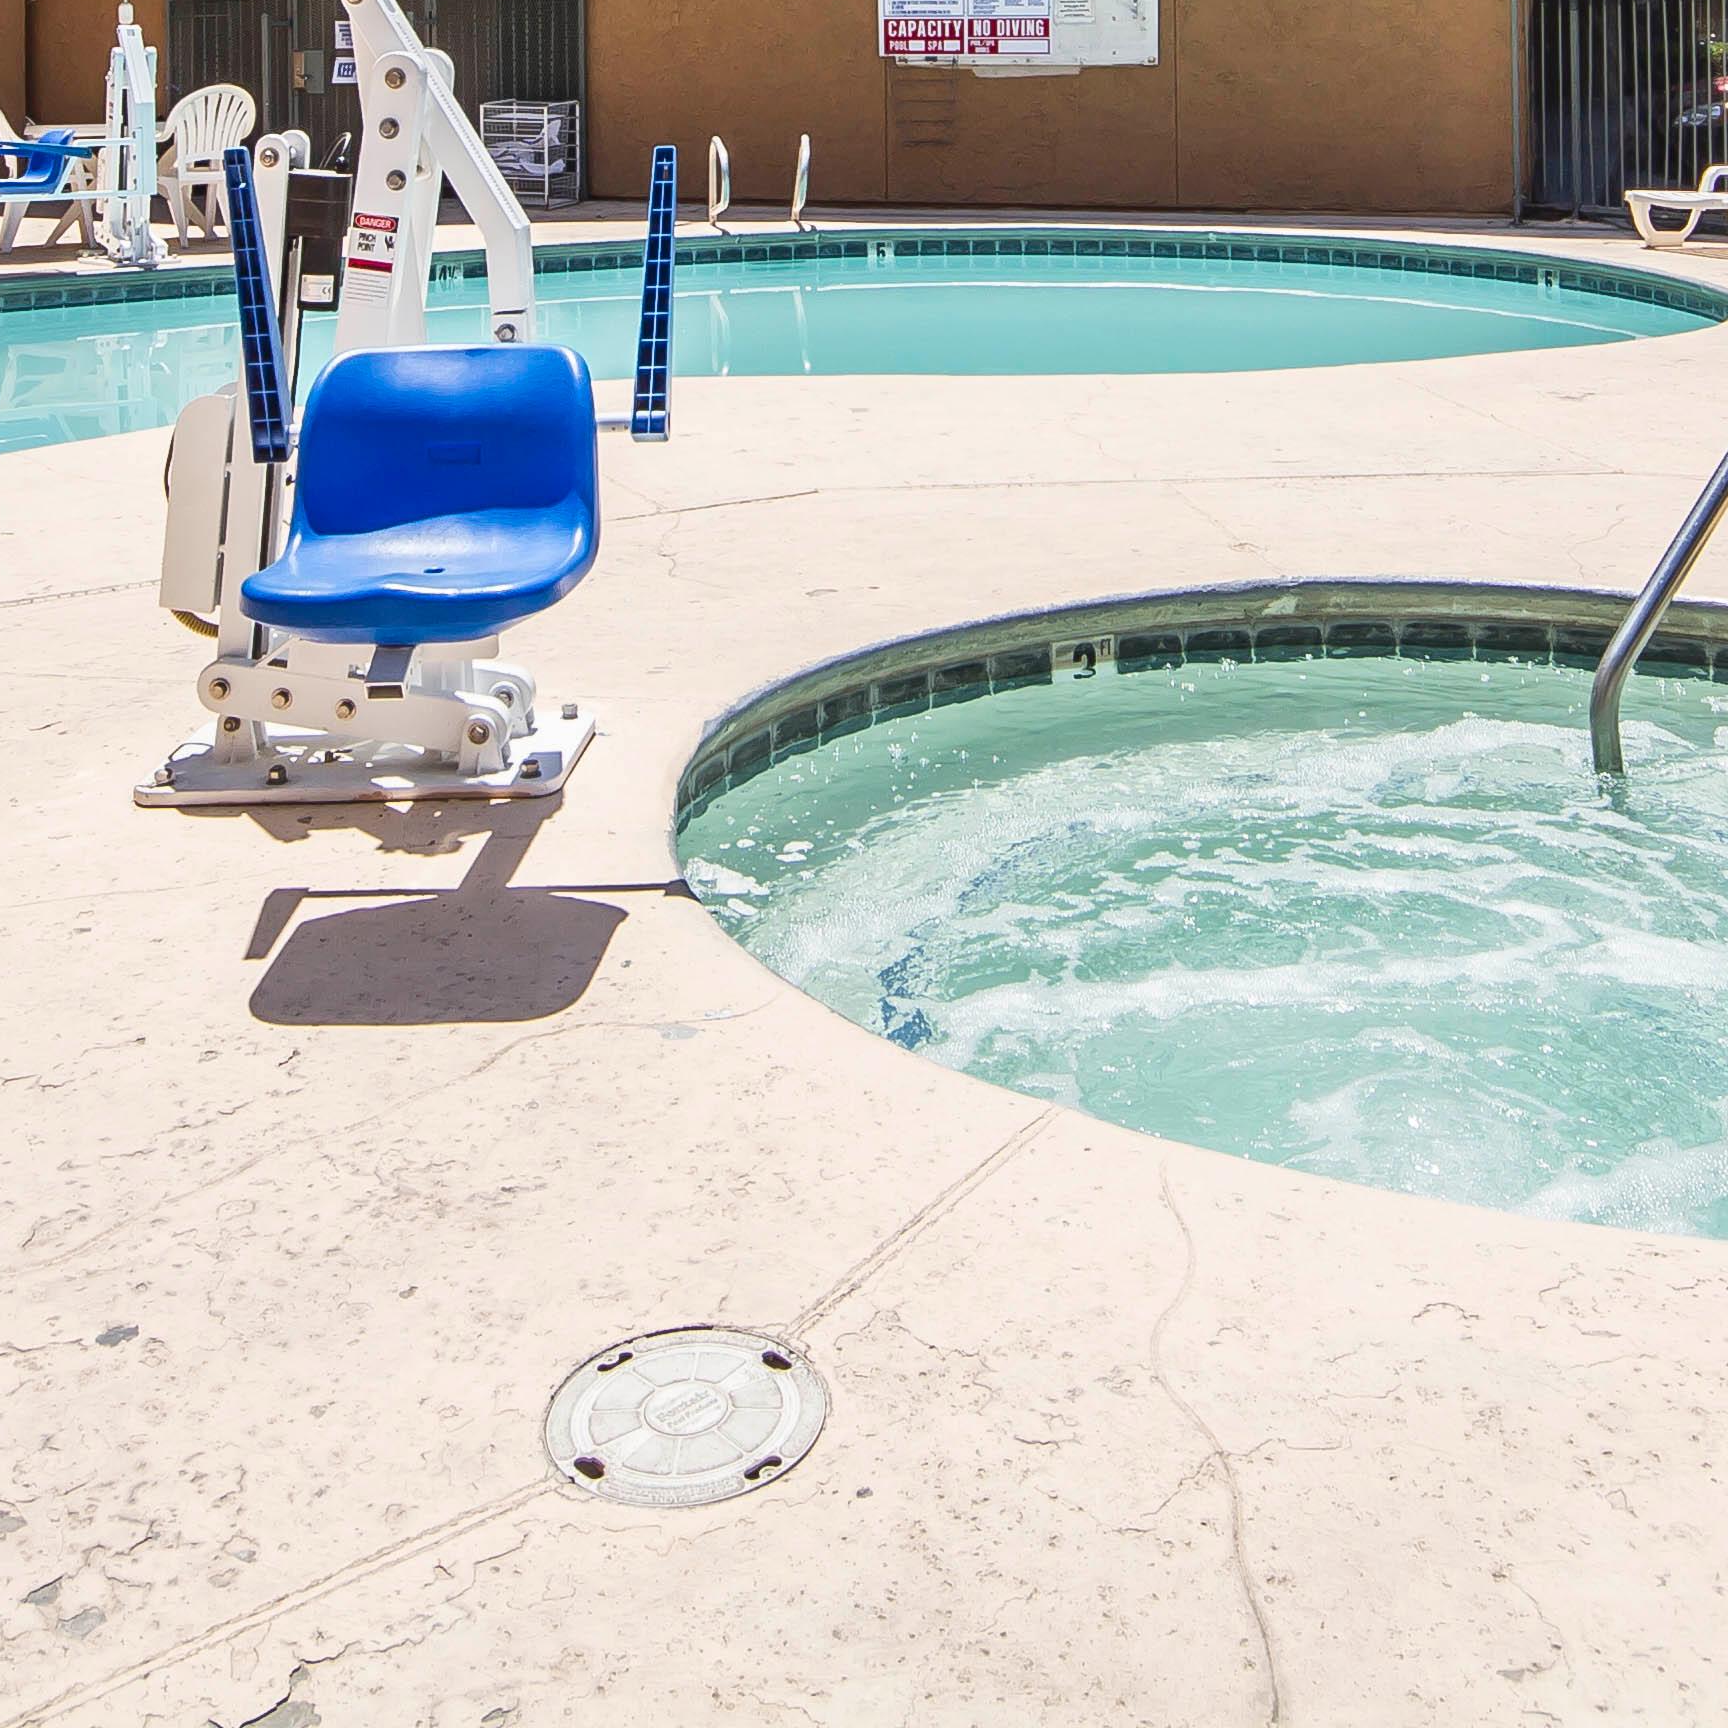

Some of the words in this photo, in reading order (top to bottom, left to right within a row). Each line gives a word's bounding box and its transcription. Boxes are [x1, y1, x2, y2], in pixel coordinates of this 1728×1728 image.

[888, 20, 962, 37] CAPACITY
[973, 20, 991, 37] NO
[996, 19, 1045, 37] DIVING
[889, 40, 909, 51] POOL
[927, 40, 944, 52] SPA
[359, 216, 392, 229] DANGER
[358, 232, 377, 243] PINCH
[357, 242, 375, 252] POINT
[1100, 638, 1112, 656] FT
